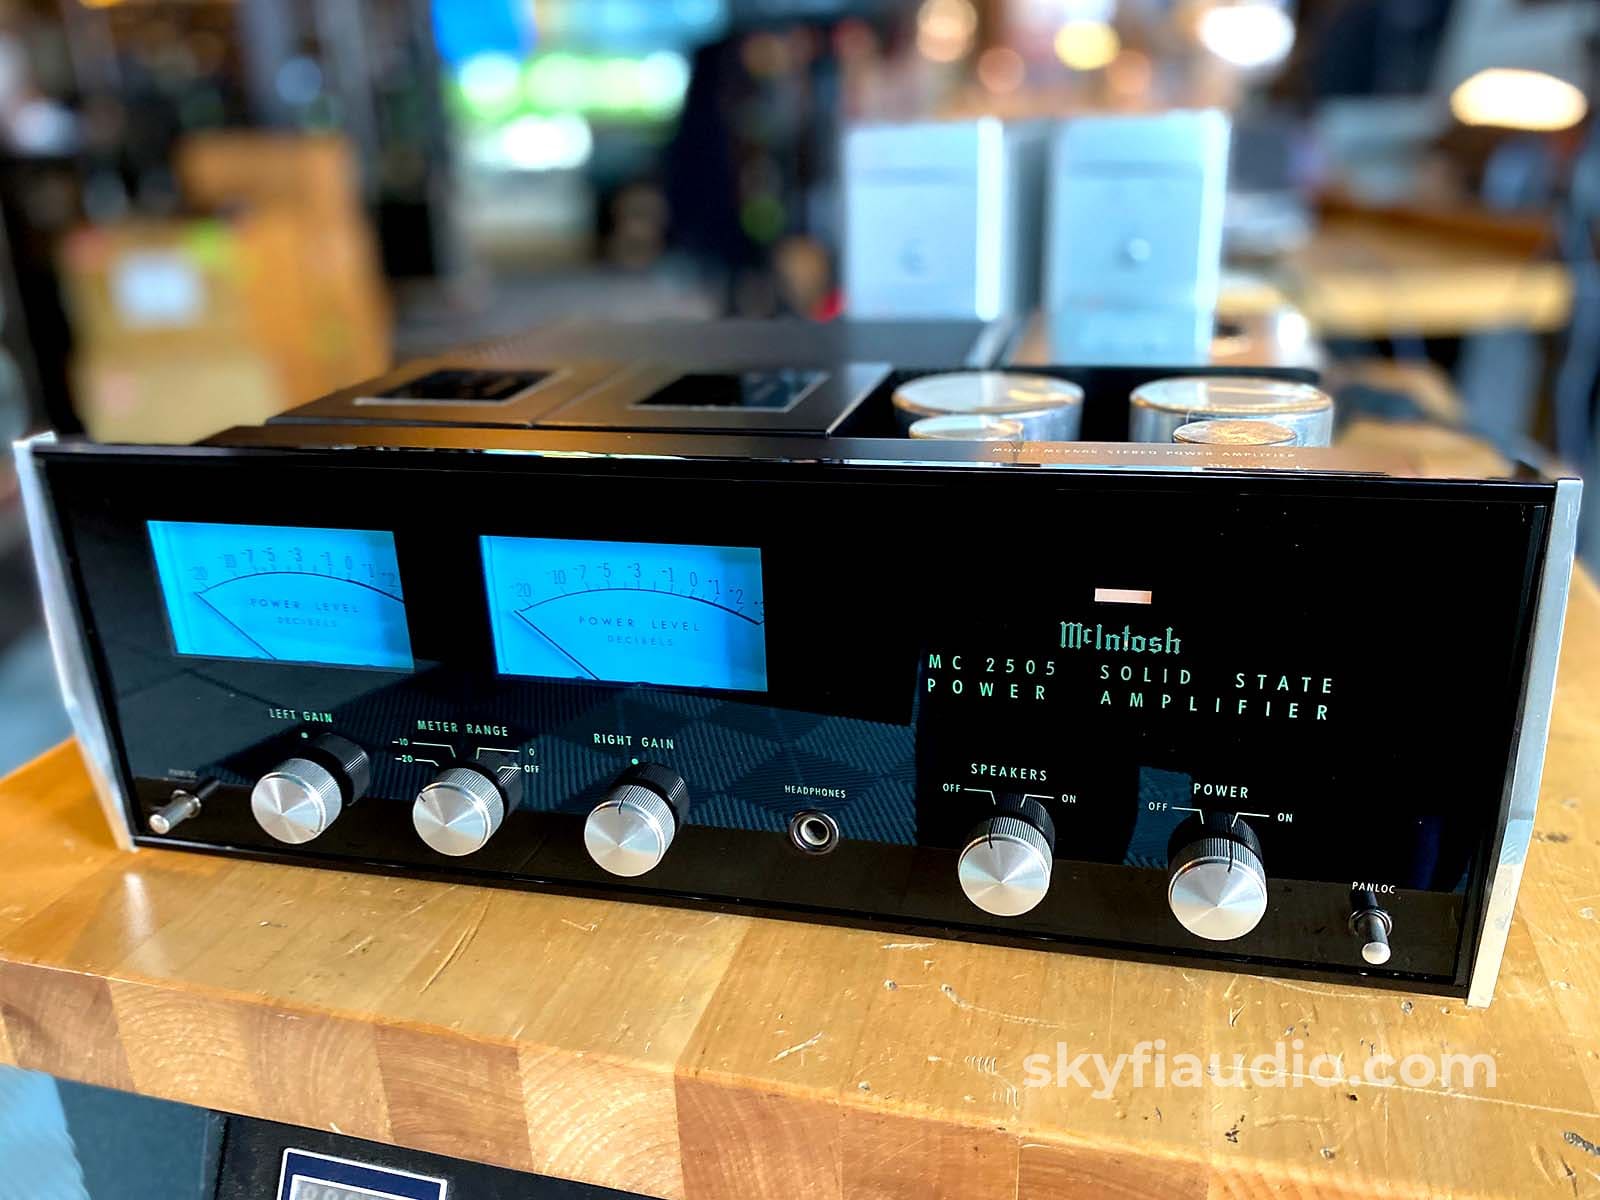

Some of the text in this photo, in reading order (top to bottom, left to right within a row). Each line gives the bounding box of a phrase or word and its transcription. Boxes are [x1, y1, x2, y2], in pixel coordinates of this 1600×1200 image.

[689, 571, 698, 587] 0
[250, 598, 360, 613] POWER LEVEL
[579, 615, 700, 632] POWER LEVEL
[607, 634, 674, 647] DECIBELS
[1059, 620, 1182, 655] McIntosh
[928, 653, 1334, 695] MC 2505 SOLID STATE
[927, 678, 1329, 721] POWER AMPLIFIER
[268, 707, 333, 723] LEFT GAIN
[416, 719, 509, 738] METER RANGE
[593, 733, 675, 750] RIGHT GAIN
[524, 764, 540, 774] OFF
[969, 762, 1048, 782] SPEAKERS
[783, 784, 847, 799] HEADPHONES
[942, 783, 962, 794] OFF
[1193, 782, 1249, 799] POWER
[1061, 793, 1077, 804] ON
[1147, 801, 1169, 812] OFF
[1277, 812, 1294, 823] ON
[1351, 880, 1397, 895] PANLOC
